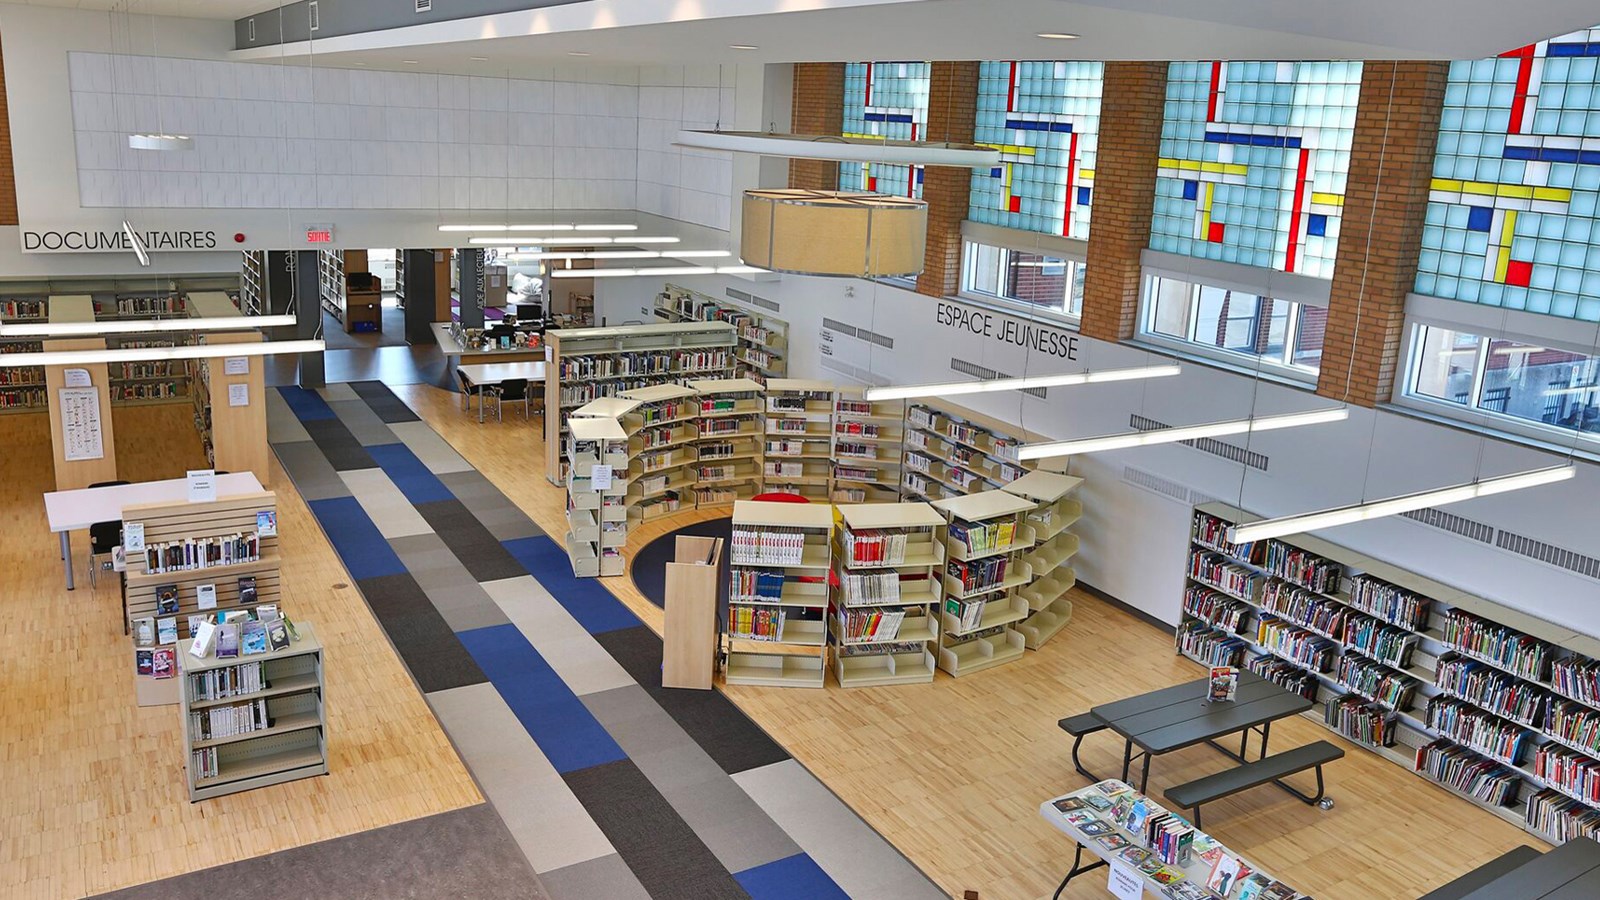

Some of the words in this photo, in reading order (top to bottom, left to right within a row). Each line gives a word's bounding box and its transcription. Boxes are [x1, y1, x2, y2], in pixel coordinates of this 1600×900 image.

[23, 230, 217, 251] DOCUMENTAIRES
[307, 231, 331, 242] SORTIE
[936, 302, 993, 337] ESPACE
[996, 319, 1079, 361] JEUNESSE
